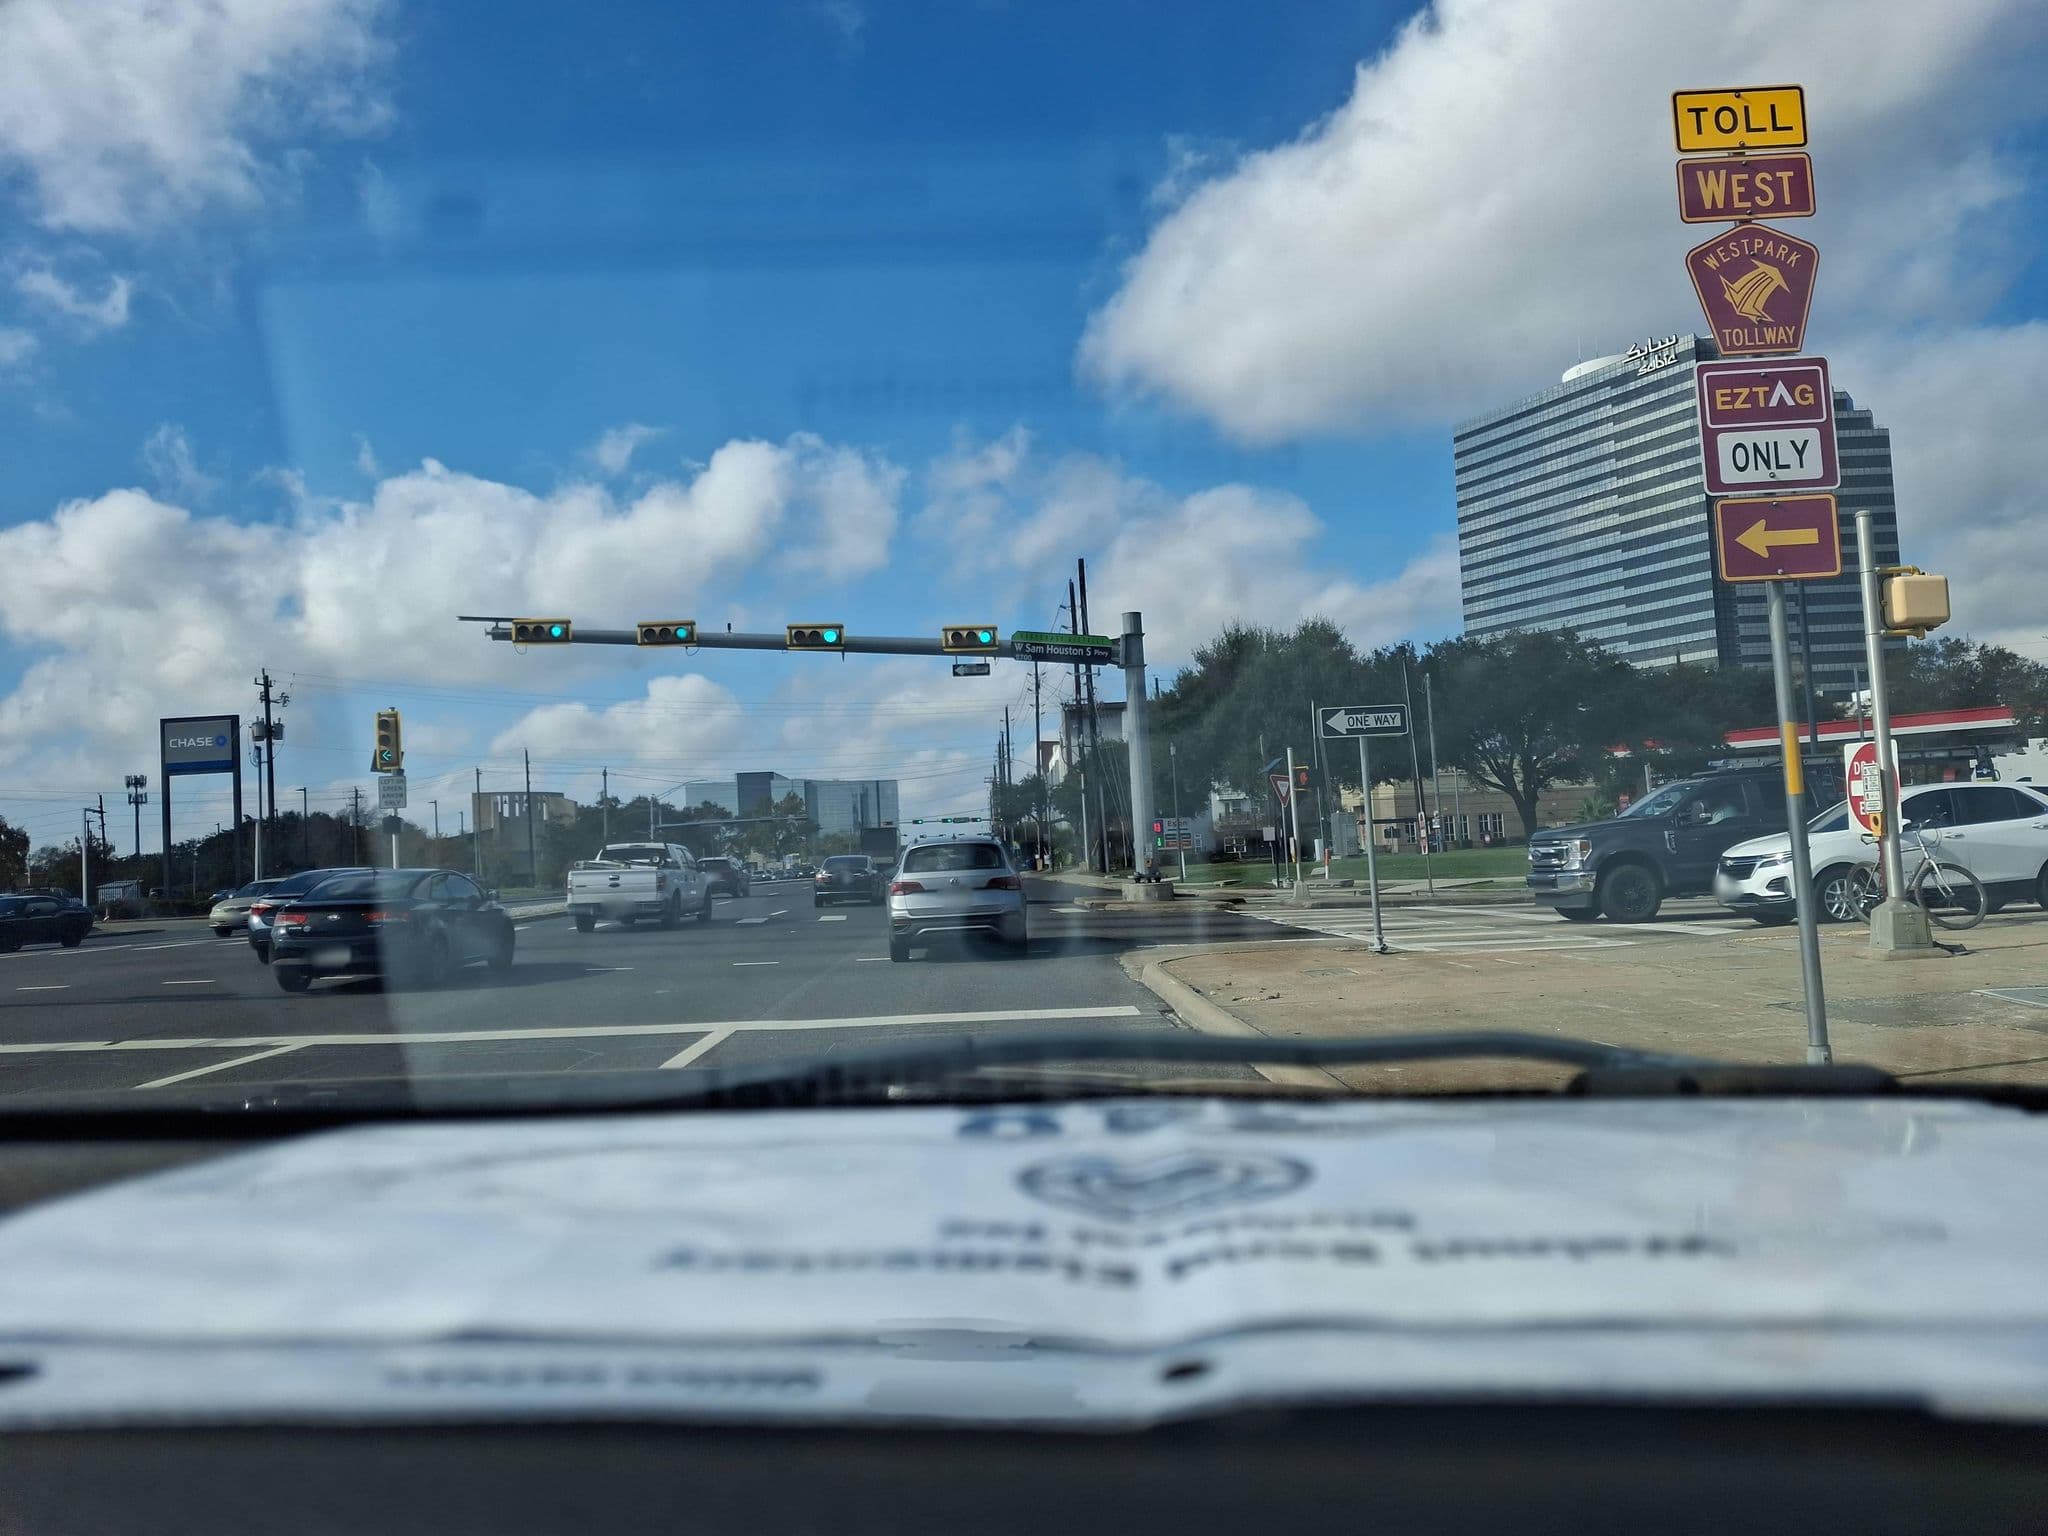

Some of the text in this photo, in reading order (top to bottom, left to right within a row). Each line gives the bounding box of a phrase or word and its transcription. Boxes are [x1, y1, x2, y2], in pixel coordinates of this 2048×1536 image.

[1687, 104, 1794, 136] TOLL
[1696, 169, 1794, 209] WEST
[1703, 238, 1802, 271] WESTPARK
[1723, 326, 1796, 347] TOLLWAY
[1732, 439, 1810, 472] ONLY
[1014, 642, 1023, 651] W
[1025, 643, 1044, 654] Sam
[1046, 645, 1084, 656] Houston
[1086, 647, 1092, 657] S
[1347, 714, 1397, 727] ONE WAY
[169, 736, 213, 748] CHASE
